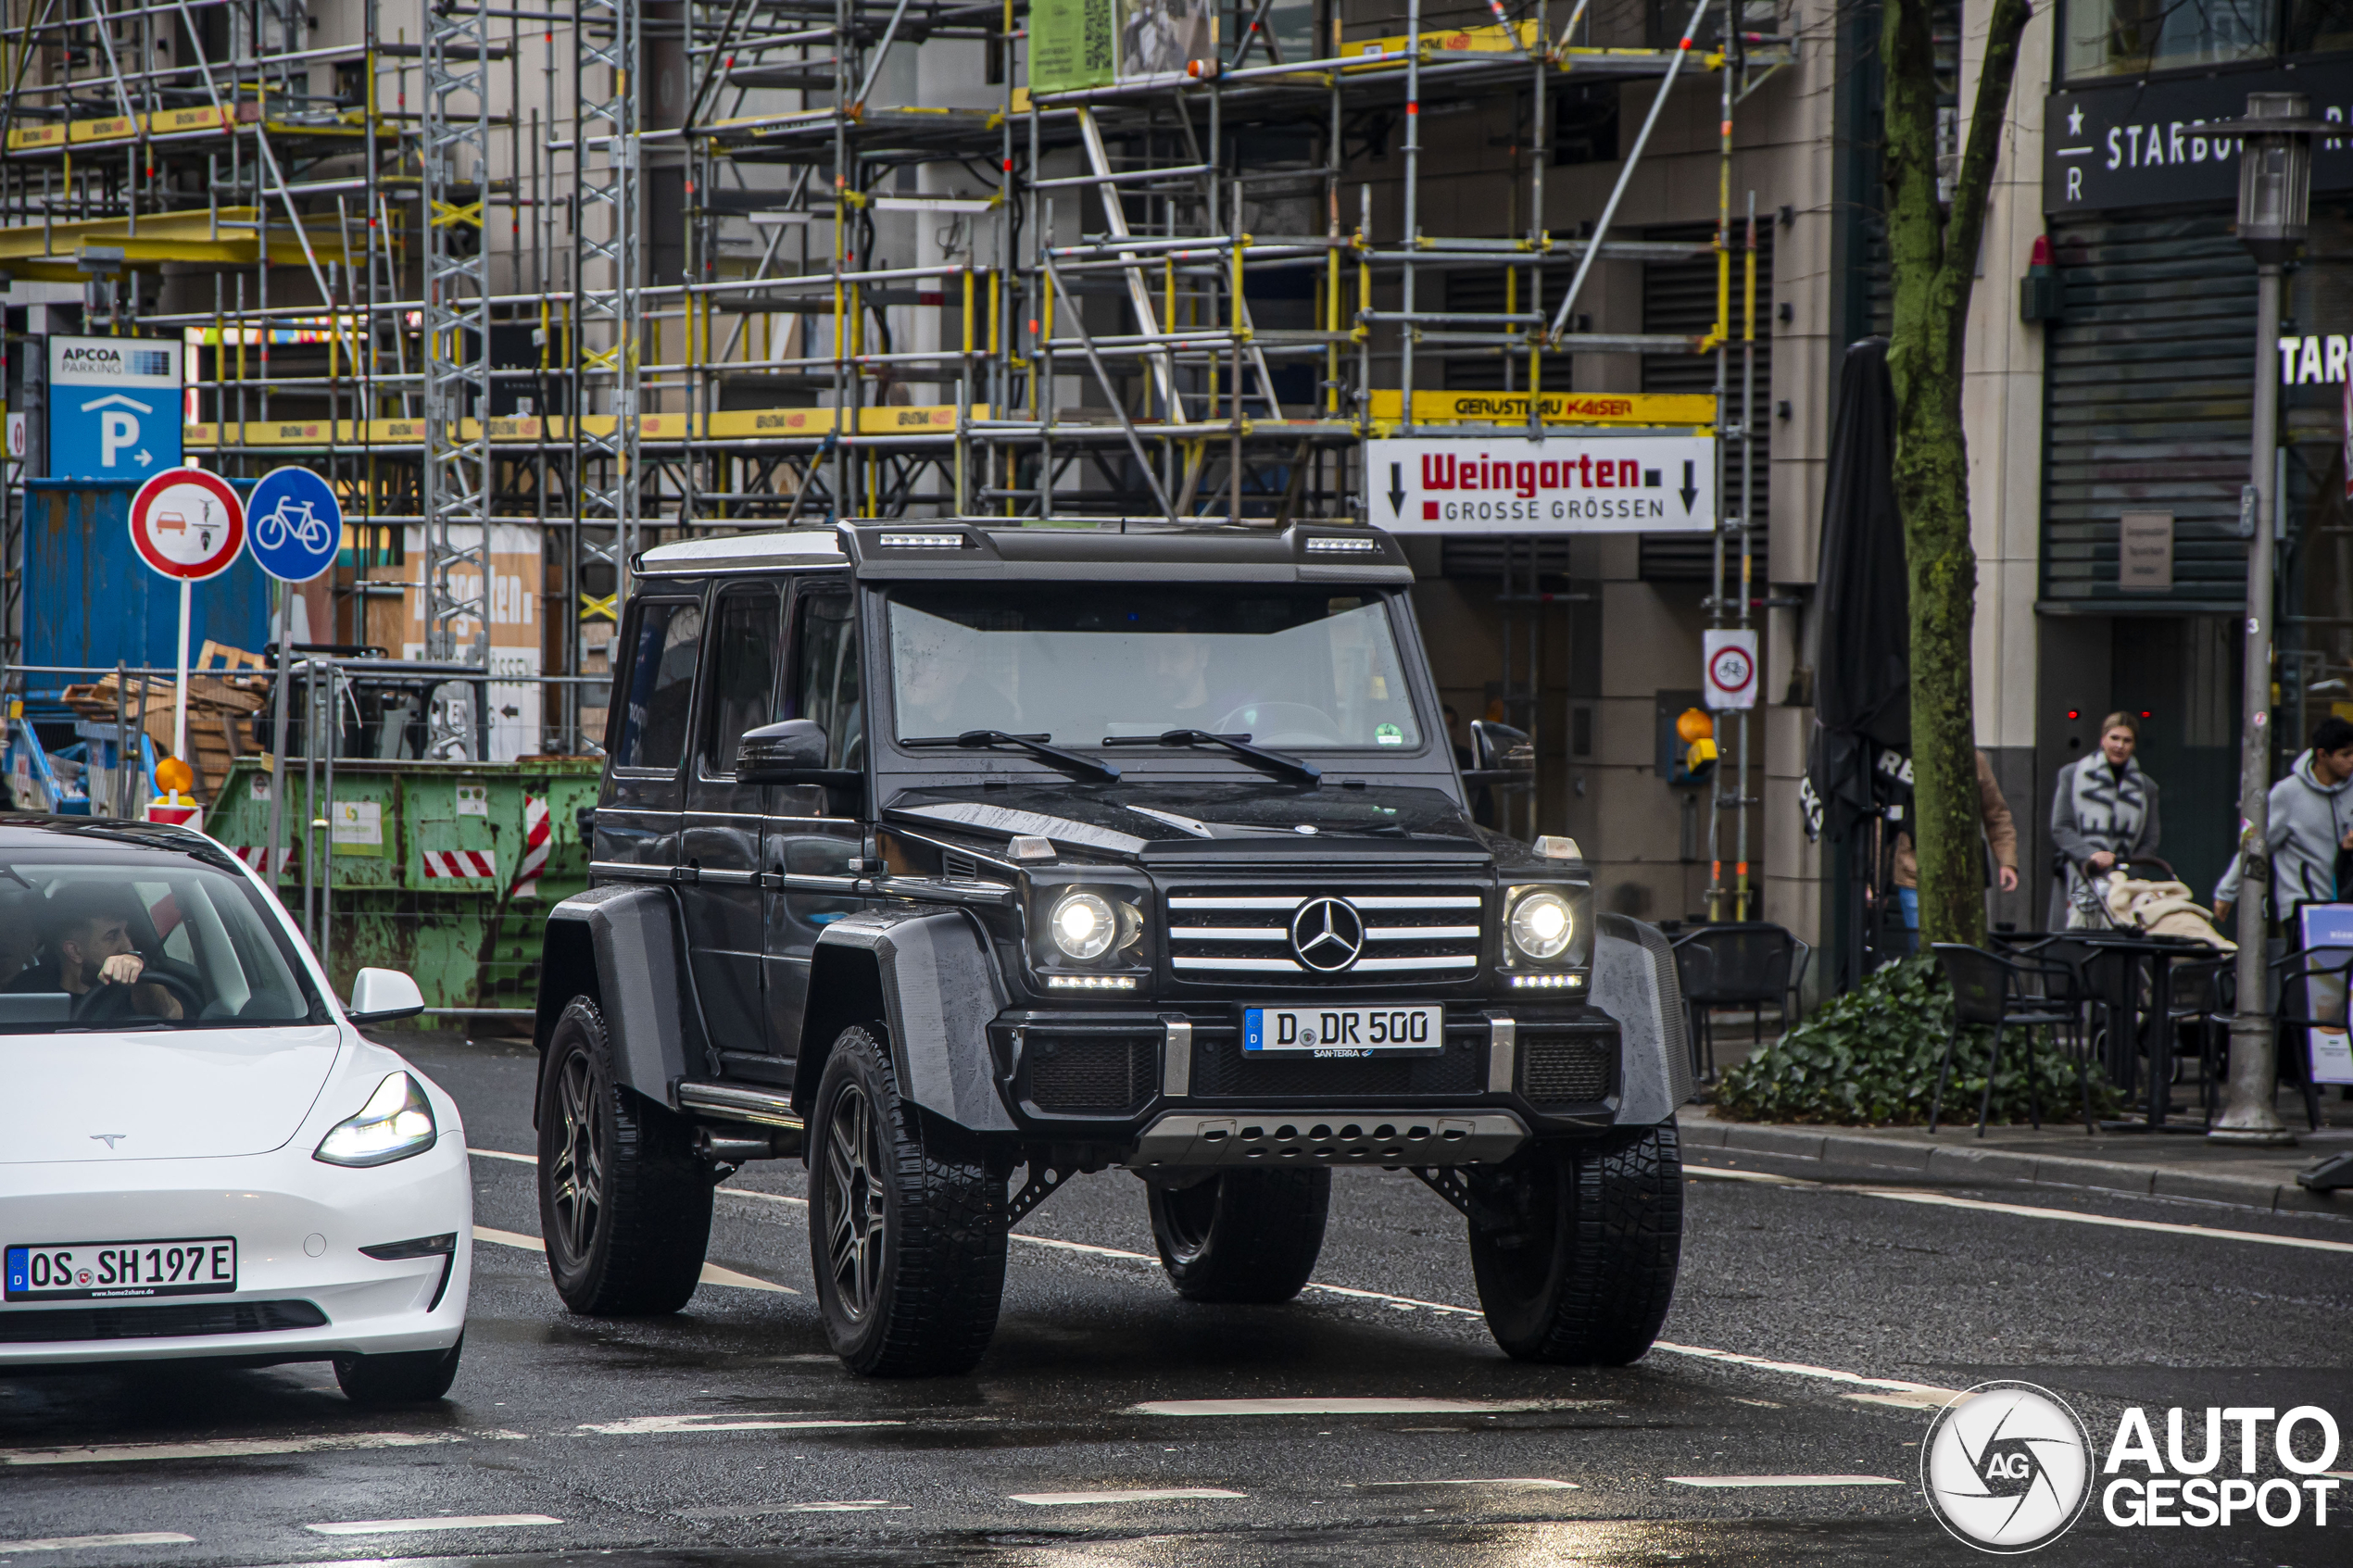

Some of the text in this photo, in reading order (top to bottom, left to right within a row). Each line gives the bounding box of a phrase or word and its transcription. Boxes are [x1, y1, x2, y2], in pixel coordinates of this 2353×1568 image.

[63, 347, 121, 361] APCOA
[2279, 334, 2353, 385] TAR
[62, 360, 122, 375] PARKING
[1567, 398, 1632, 416] KAISER
[101, 410, 140, 468] P
[1445, 496, 1664, 521] GROSSE GRÖSSEN
[1250, 1011, 1428, 1044] D D DR 500
[14, 1274, 22, 1286] D
[31, 1251, 73, 1286] OS
[91, 1288, 155, 1298] www.home2share.de
